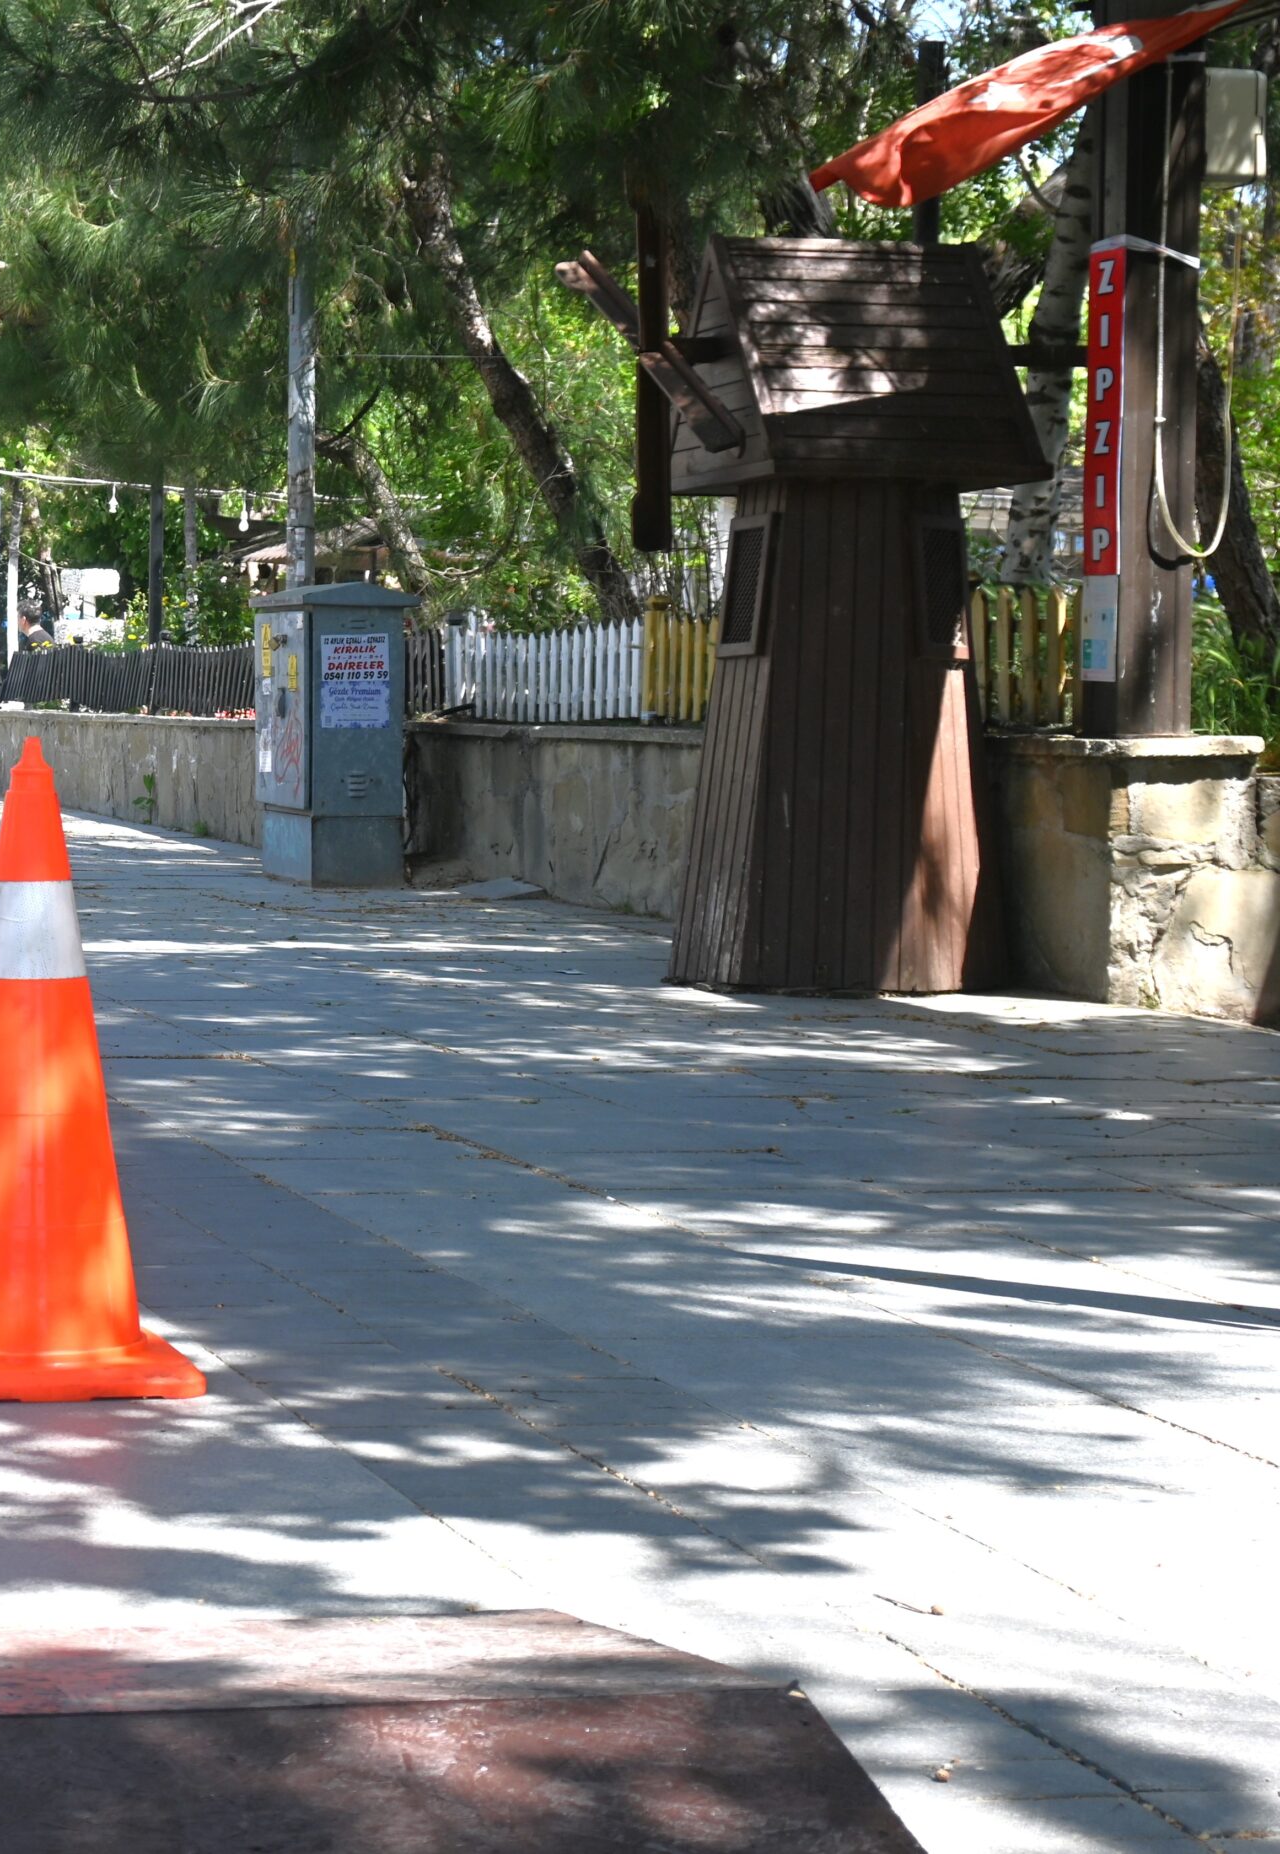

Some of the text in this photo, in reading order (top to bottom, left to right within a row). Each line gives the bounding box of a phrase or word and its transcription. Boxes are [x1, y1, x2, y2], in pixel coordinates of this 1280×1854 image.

[328, 660, 384, 671] DAİRELER
[324, 670, 389, 680] 0541 110 59 59
